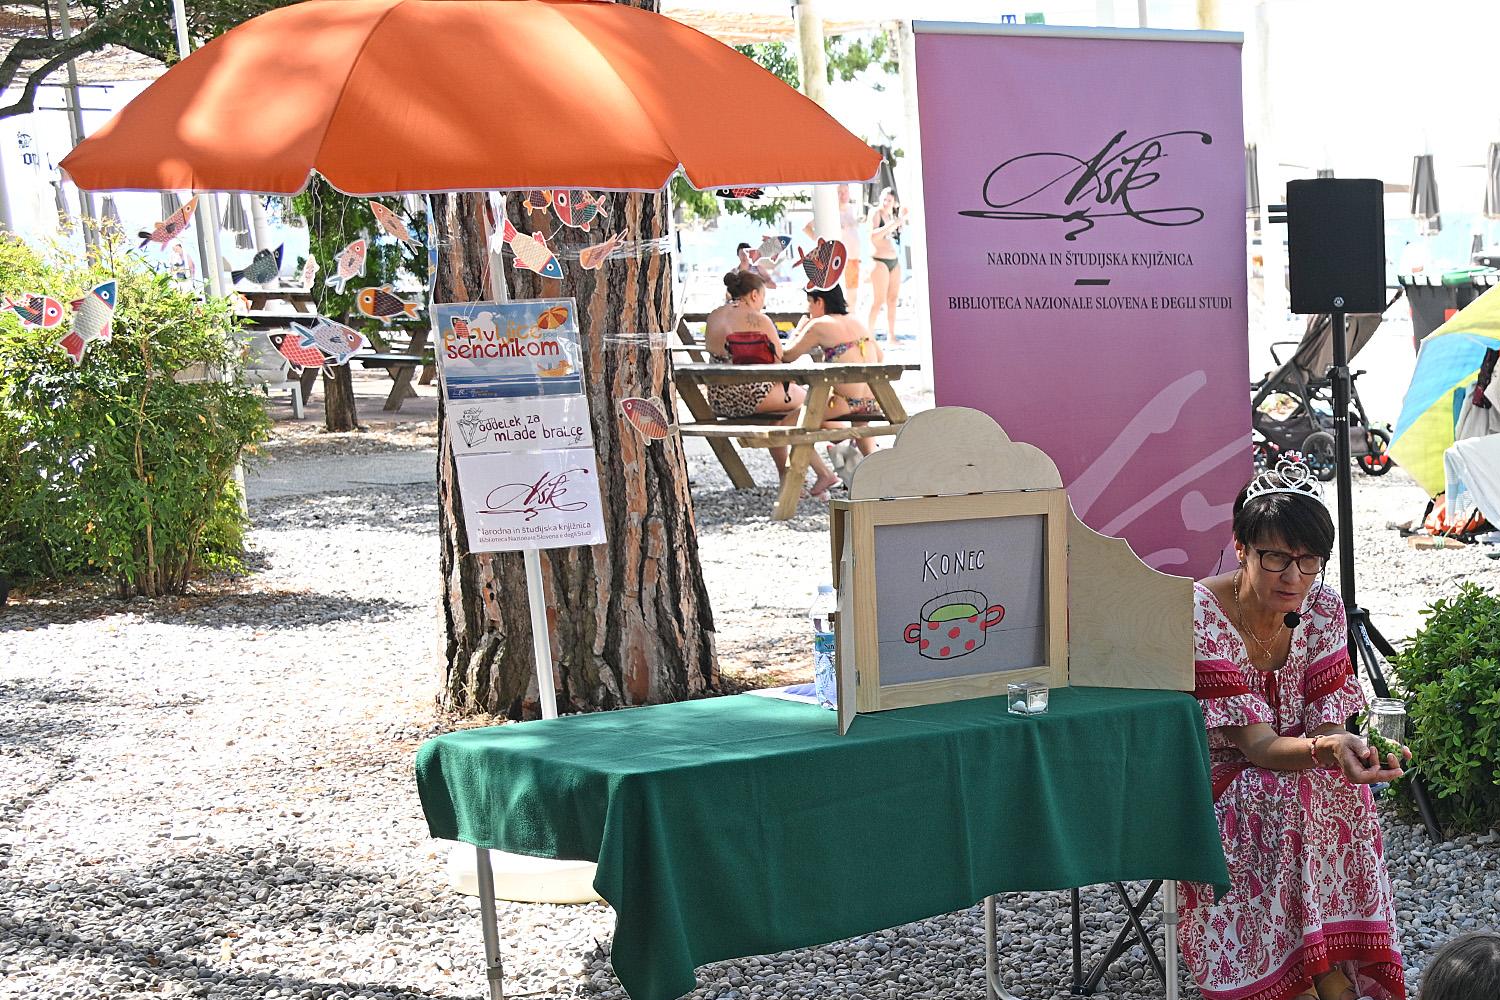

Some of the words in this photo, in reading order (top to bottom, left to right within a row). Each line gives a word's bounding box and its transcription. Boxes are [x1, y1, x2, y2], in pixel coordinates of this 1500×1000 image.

[987, 252, 1047, 266] NARODNA
[1049, 252, 1063, 266] IN
[1065, 250, 1128, 268] ŠTUDIJSKA
[1131, 250, 1194, 269] KNJIŽNICA
[948, 296, 1022, 310] BIBLIOTECA
[1024, 296, 1094, 310] NAZIONALE
[1095, 296, 1149, 310] SLOVENA
[1150, 296, 1159, 310] E
[1160, 296, 1196, 310] DEGLI
[1198, 296, 1232, 310] STUDI
[528, 414, 540, 424] za
[921, 549, 986, 583] KONEC
